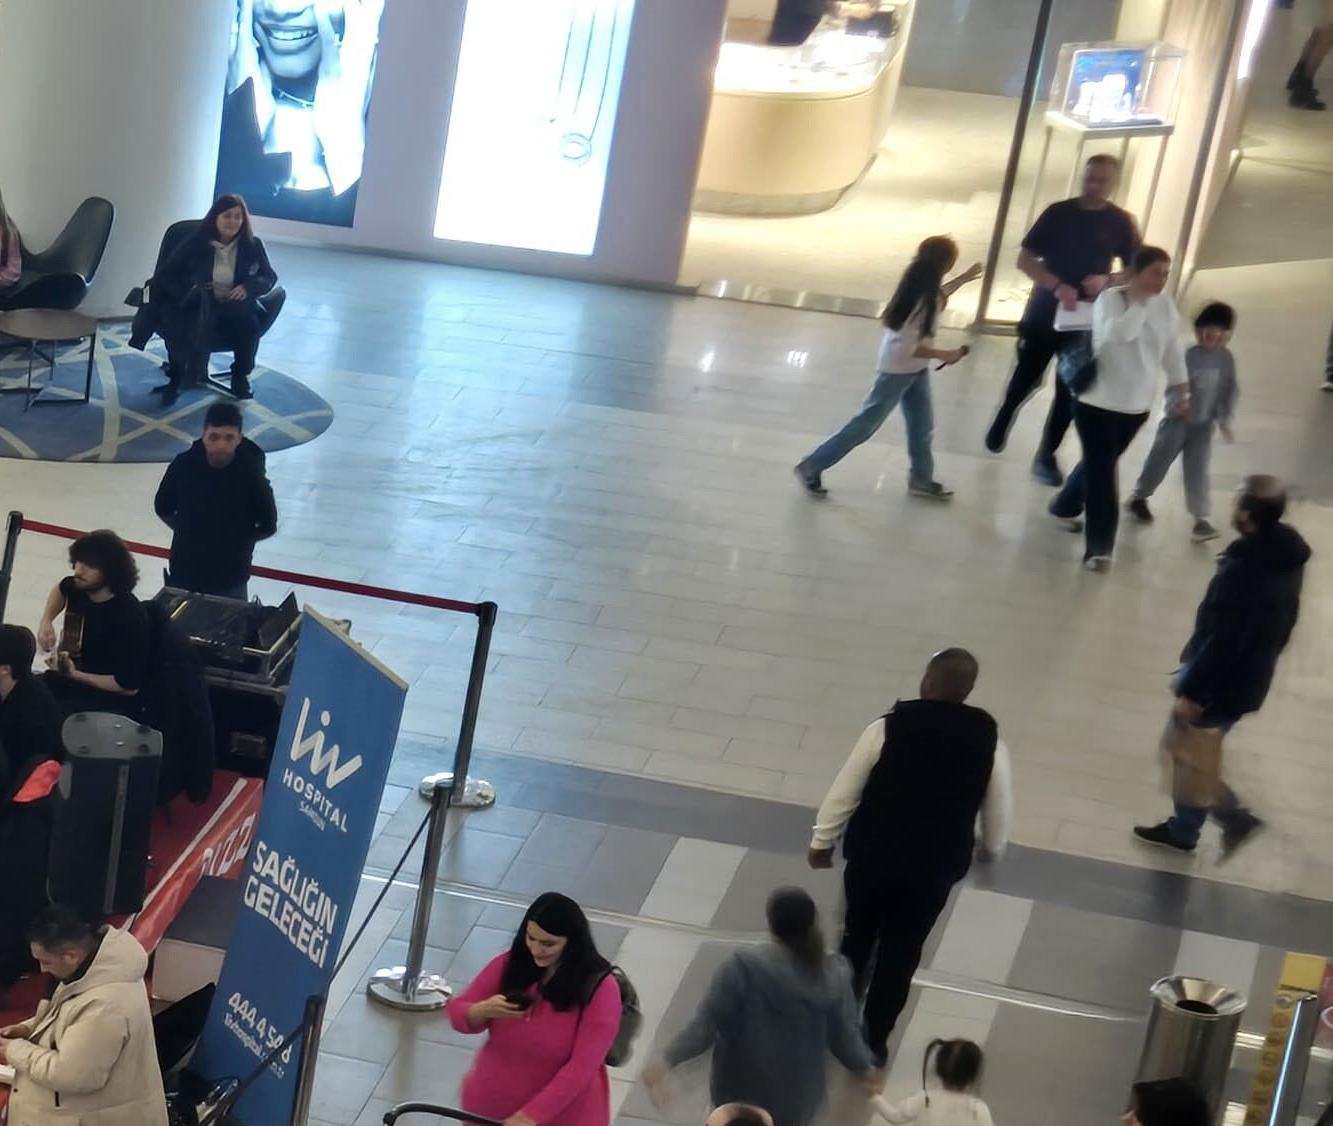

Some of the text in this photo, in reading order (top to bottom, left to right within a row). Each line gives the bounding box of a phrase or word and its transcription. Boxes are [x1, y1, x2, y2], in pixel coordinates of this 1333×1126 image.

[283, 768, 348, 833] HOSPITAL
[244, 875, 329, 969] GELECEĞİ
[252, 840, 338, 935] SAĞLIĞIN
[228, 992, 257, 1029] 444
[256, 1017, 267, 1039] 4
